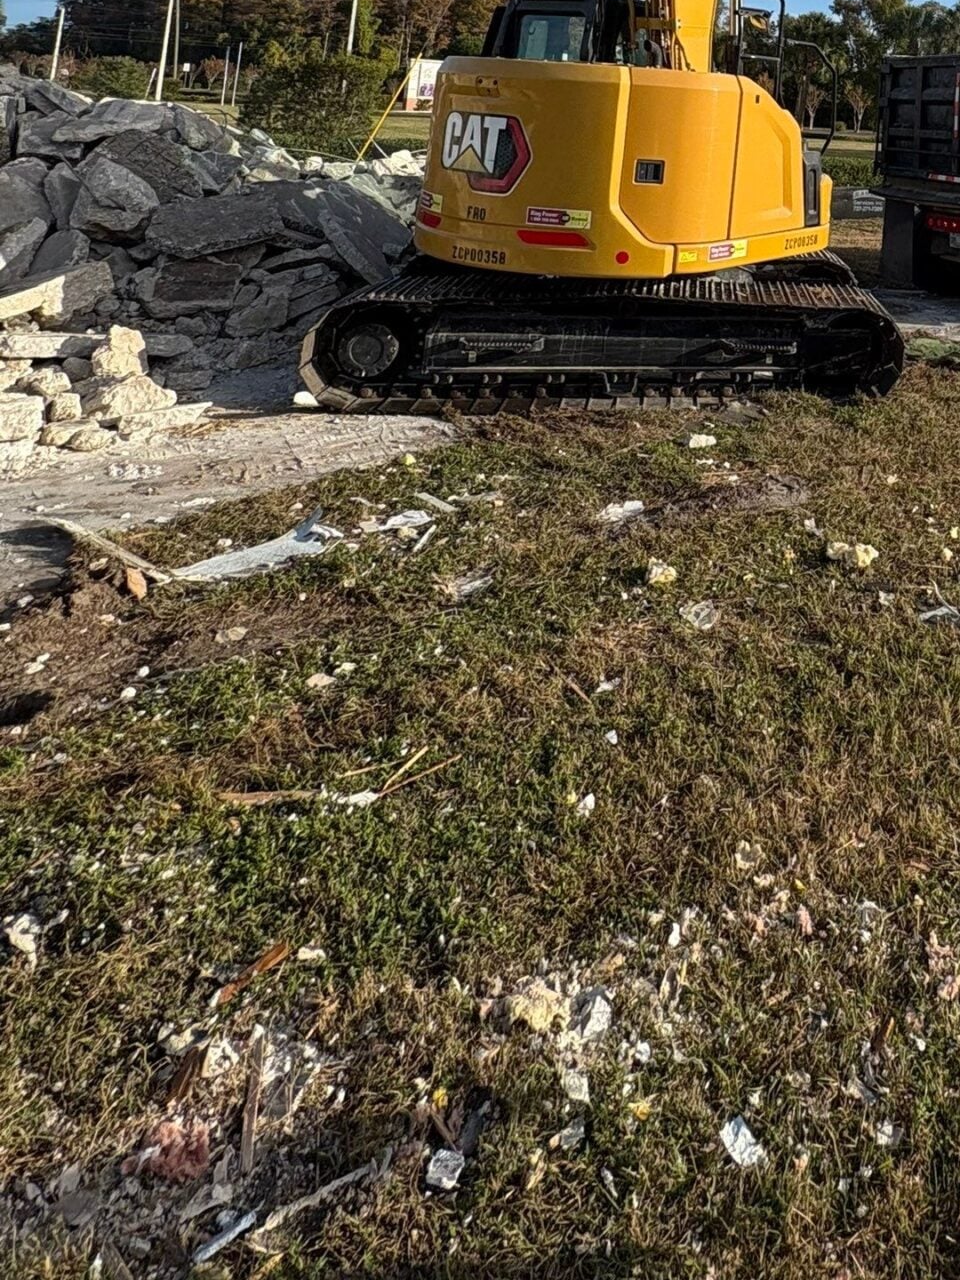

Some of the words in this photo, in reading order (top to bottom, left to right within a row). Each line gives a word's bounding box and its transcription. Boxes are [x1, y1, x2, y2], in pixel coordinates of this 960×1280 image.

[442, 111, 507, 174] CAT
[784, 234, 818, 250] ZCP00358
[452, 245, 506, 265] ZCP00358
